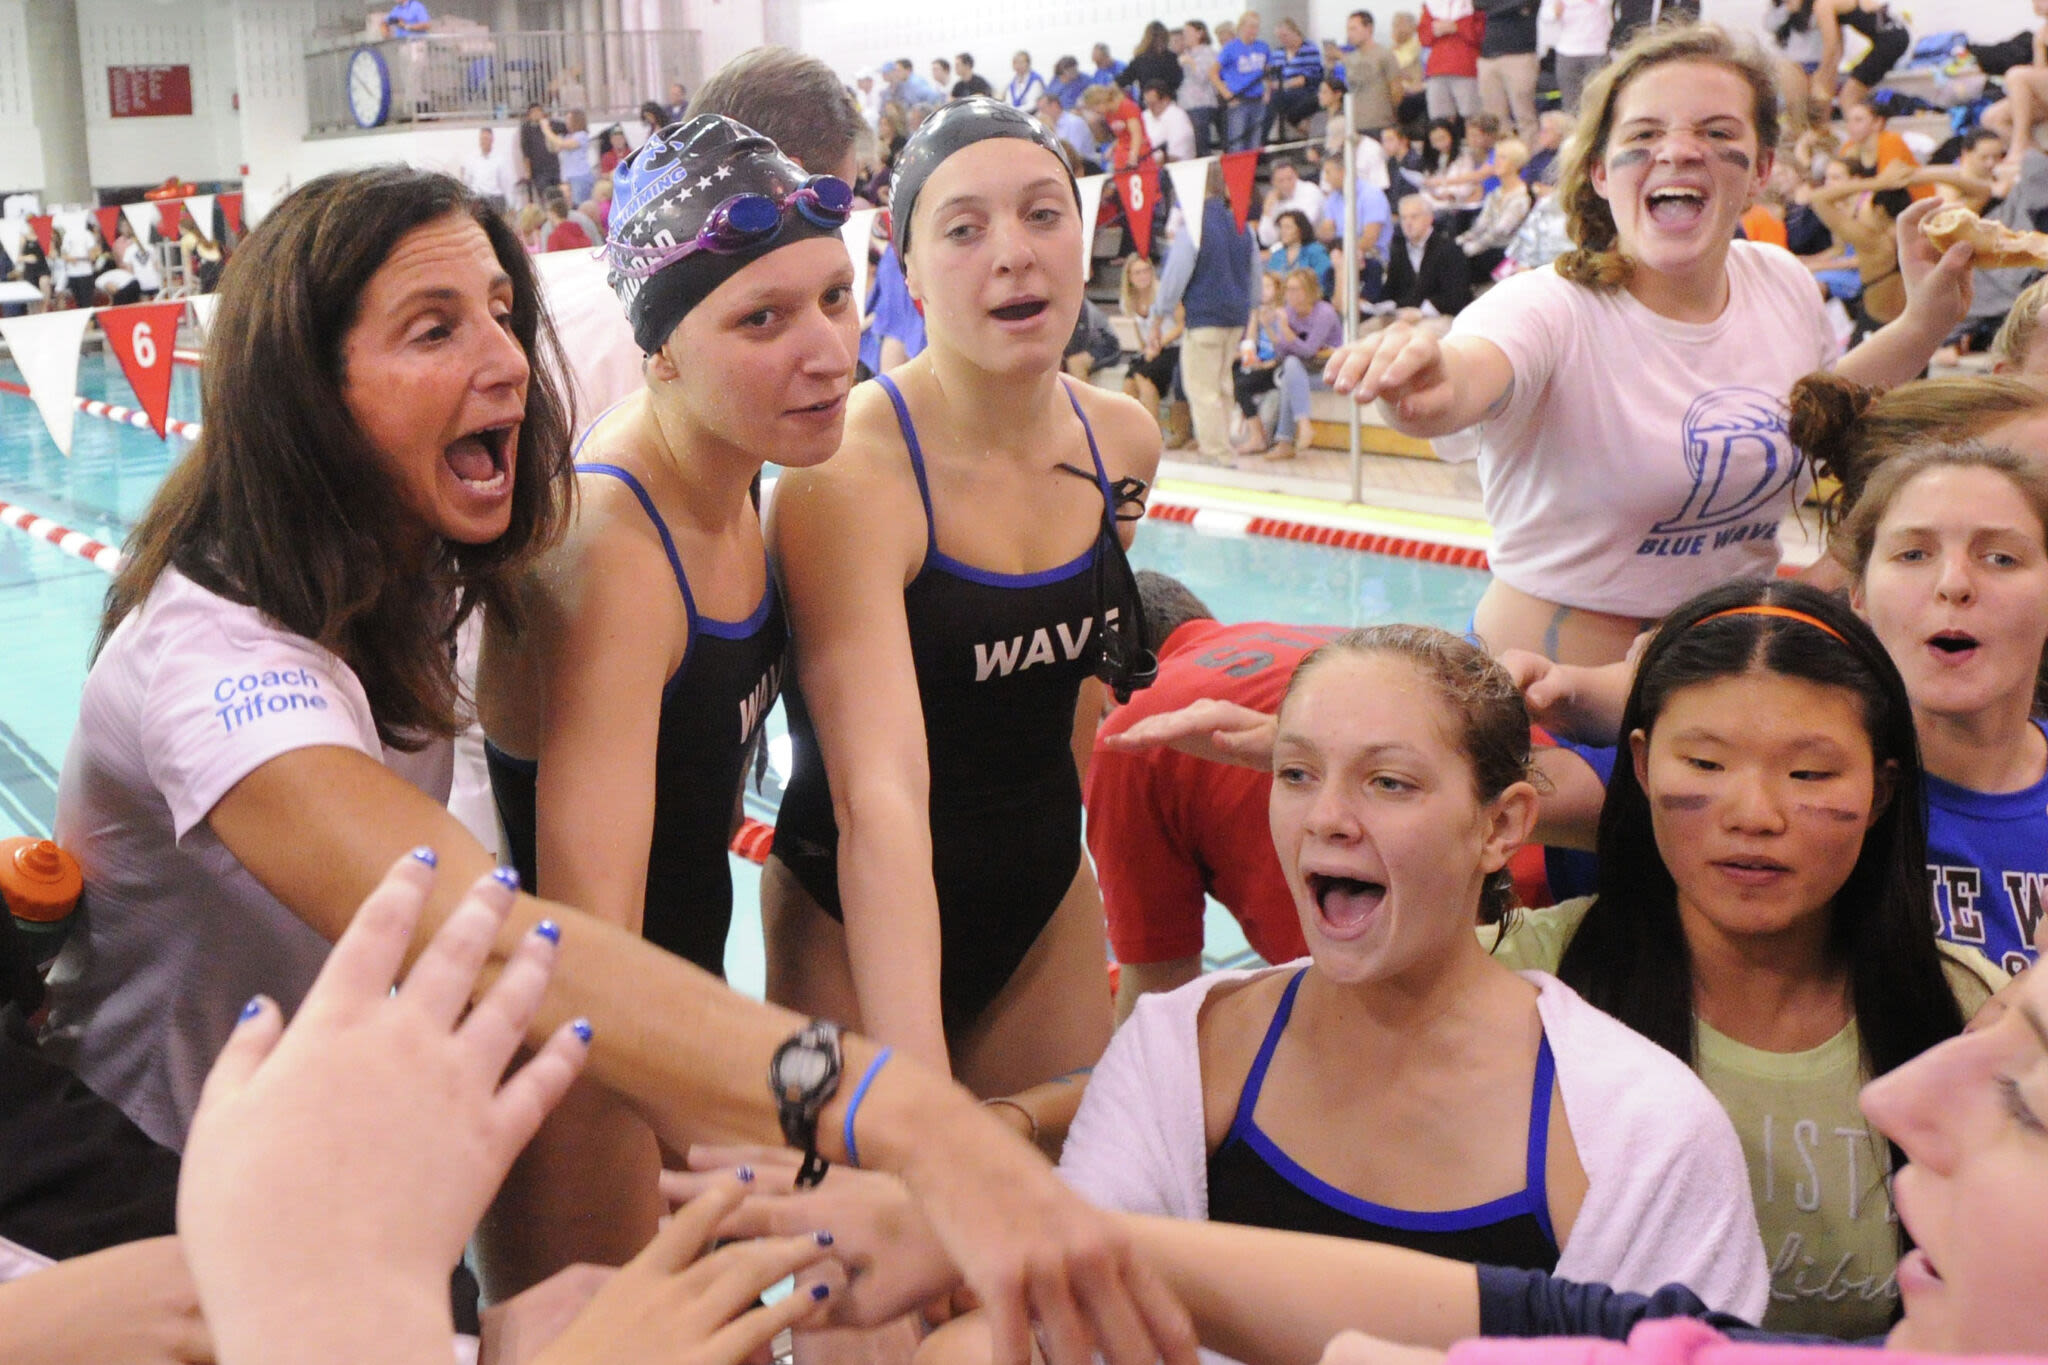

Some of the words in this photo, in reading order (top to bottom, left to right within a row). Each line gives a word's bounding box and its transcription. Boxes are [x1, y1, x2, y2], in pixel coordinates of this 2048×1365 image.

[1129, 174, 1144, 211] 8
[132, 321, 157, 368] 6
[1636, 535, 1707, 556] BLUE
[1713, 521, 1779, 550] WAVE
[214, 667, 319, 703] Coach
[216, 691, 329, 732] Trifone
